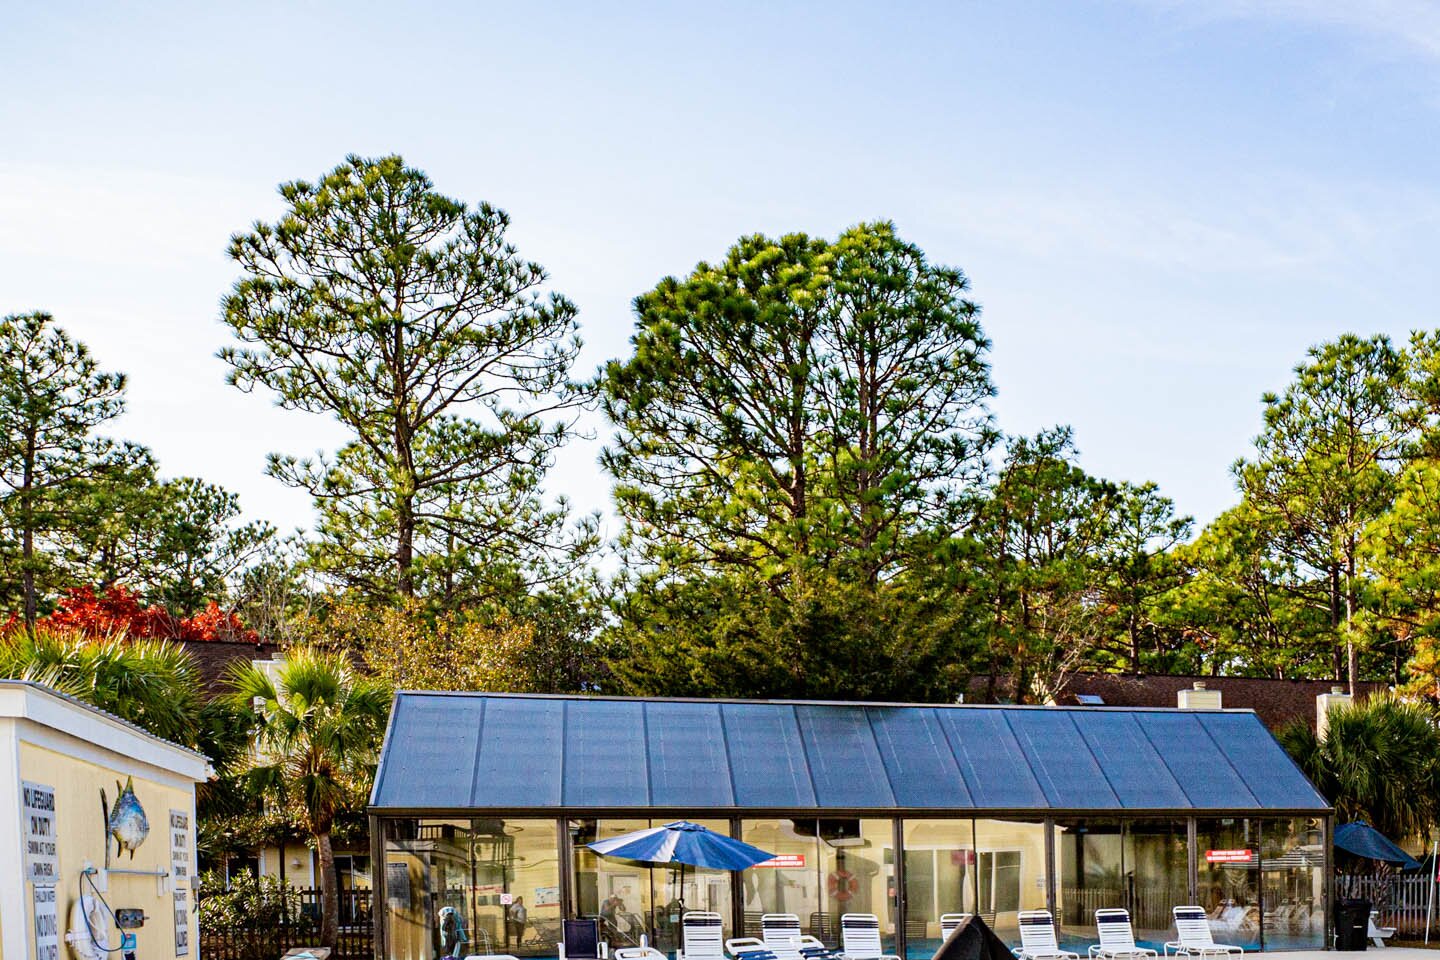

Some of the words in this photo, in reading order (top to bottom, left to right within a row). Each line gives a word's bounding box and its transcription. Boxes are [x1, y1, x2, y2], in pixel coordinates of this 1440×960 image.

[23, 788, 31, 808] NO
[31, 789, 55, 812] LIFEGUARD
[31, 816, 38, 835] ON
[38, 817, 50, 837] DUTY
